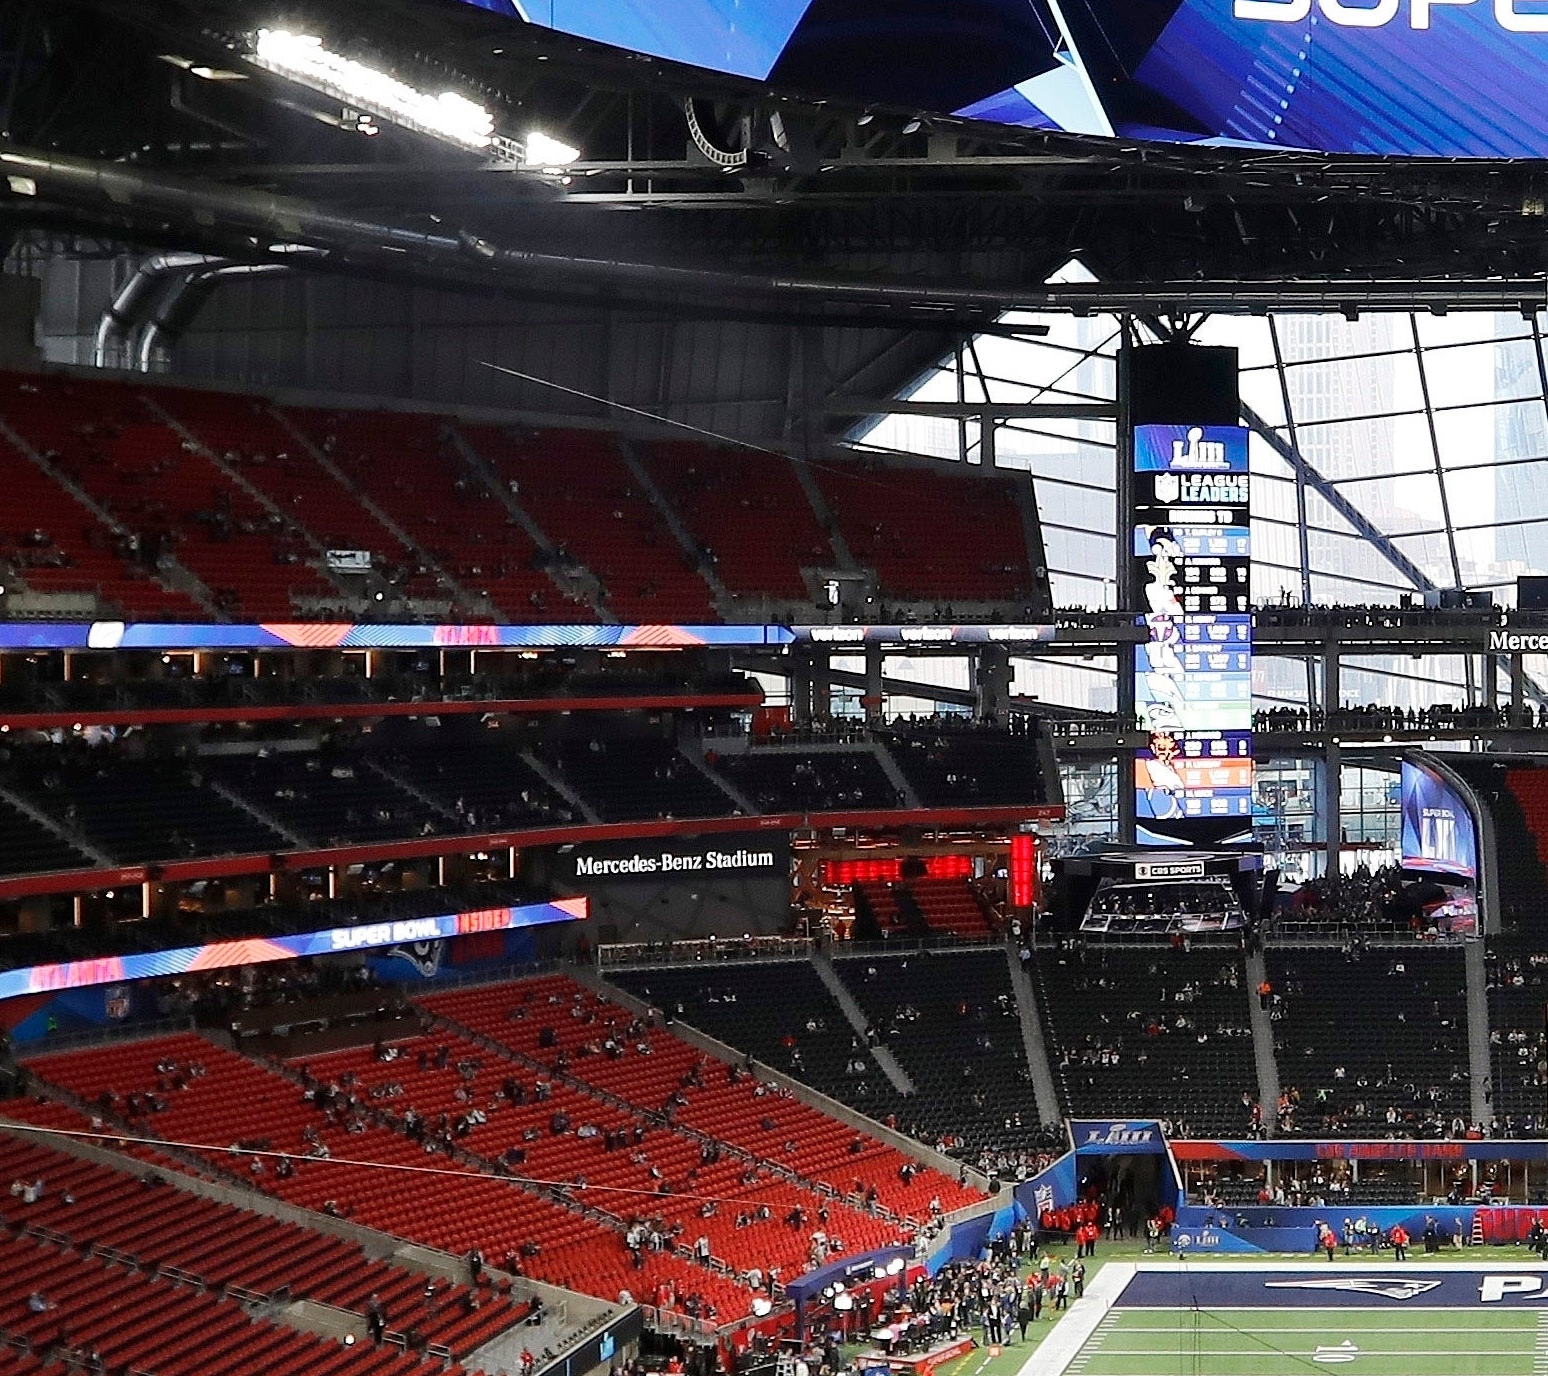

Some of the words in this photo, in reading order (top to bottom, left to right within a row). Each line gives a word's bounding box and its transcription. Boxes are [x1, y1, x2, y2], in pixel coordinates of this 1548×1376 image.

[1180, 474, 1249, 487] LEAGUE
[1180, 486, 1249, 503] LEADERS
[576, 853, 702, 876] Mercedes-Benz
[706, 850, 773, 870] Stadium
[331, 924, 390, 949] SUPER
[392, 920, 440, 943] BOWL
[1313, 1345, 1359, 1363] 10
